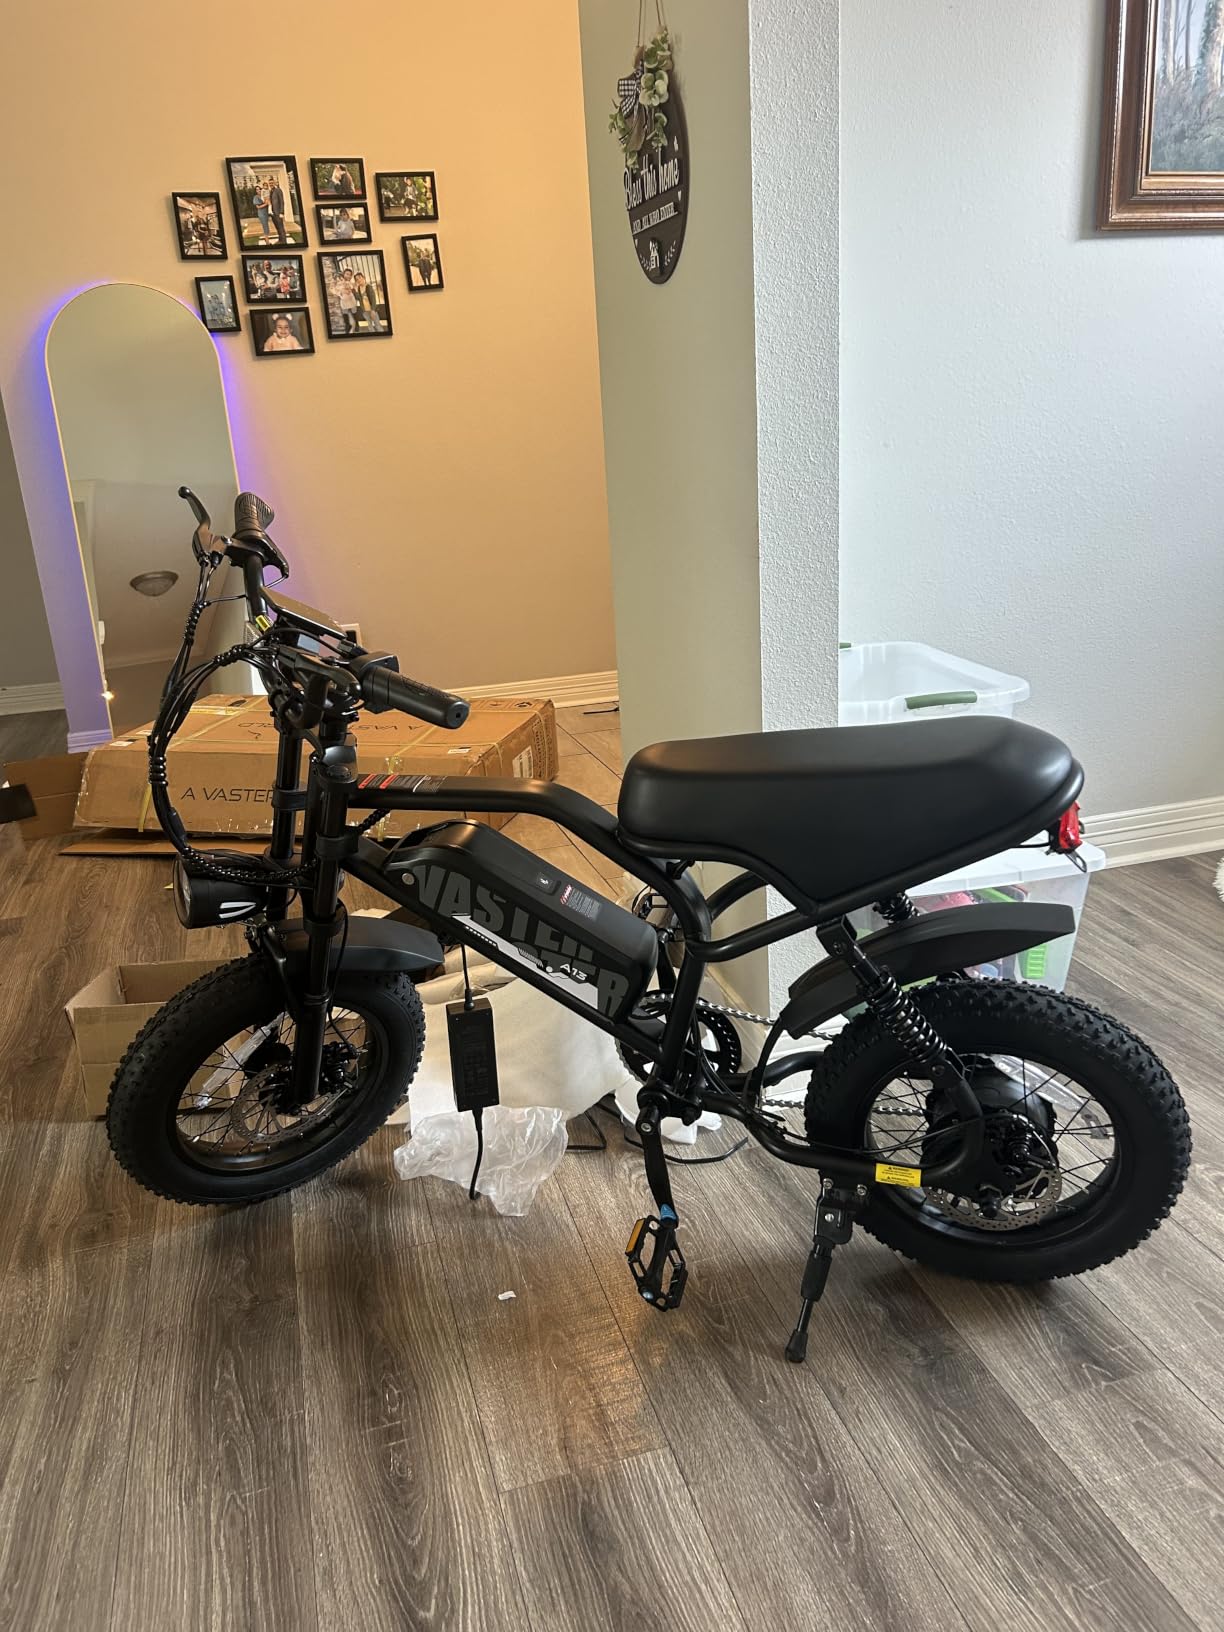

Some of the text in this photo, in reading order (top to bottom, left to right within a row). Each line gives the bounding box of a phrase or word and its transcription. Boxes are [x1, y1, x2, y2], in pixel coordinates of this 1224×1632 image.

[624, 148, 680, 210] Bless this home
[181, 787, 196, 800] A
[560, 963, 588, 981] A13
